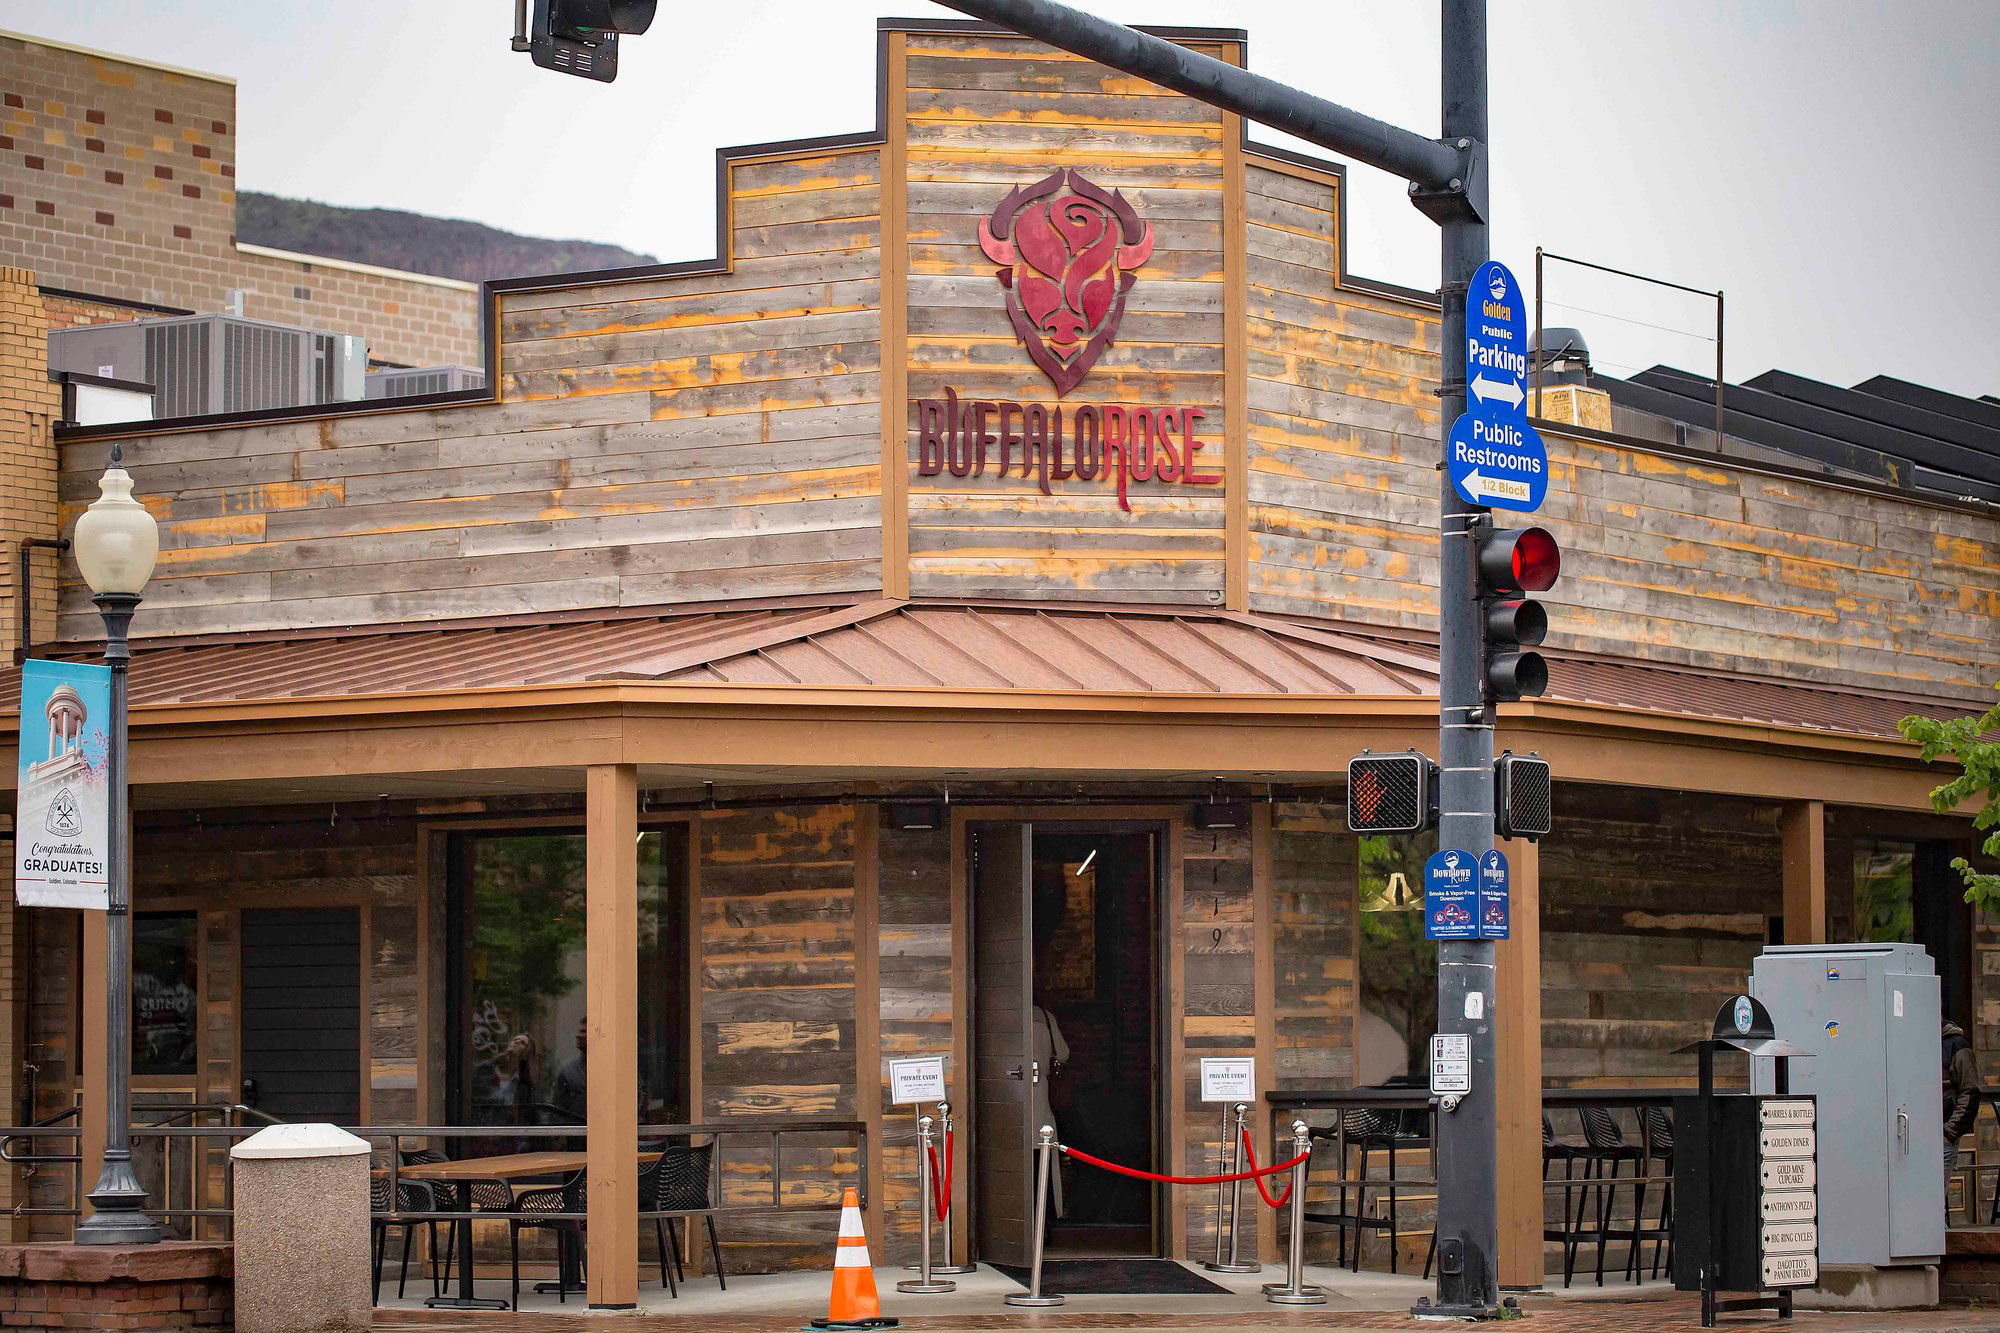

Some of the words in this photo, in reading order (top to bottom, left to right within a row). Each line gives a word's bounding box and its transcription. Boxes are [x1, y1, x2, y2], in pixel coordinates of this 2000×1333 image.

[1483, 300, 1511, 321] Golden
[1482, 325, 1512, 340] Public
[1469, 339, 1525, 380] Parking
[1474, 420, 1523, 446] Public
[1456, 441, 1541, 473] Restrooms
[1482, 479, 1496, 492] 1/2
[1499, 480, 1526, 497] Block
[24, 859, 102, 874] GRADUATES!
[1768, 1110, 1787, 1118] BARRELS
[1788, 1110, 1792, 1118] &
[1793, 1109, 1813, 1118] BOTTLES
[1771, 1138, 1792, 1148] GOLDEN
[1793, 1137, 1810, 1147] DINER
[1777, 1165, 1791, 1174] GOLD
[1792, 1164, 1805, 1173] MINE
[1778, 1174, 1804, 1184] CUPCAKES
[1769, 1201, 1798, 1212] ANTHONY'S
[1799, 1200, 1813, 1210] PIZZA
[1771, 1233, 1780, 1243] BIG
[1781, 1233, 1794, 1242] RING
[1794, 1232, 1813, 1242] CYCLES
[1774, 1269, 1792, 1280] PANINI
[1792, 1268, 1811, 1278] BISTRO
